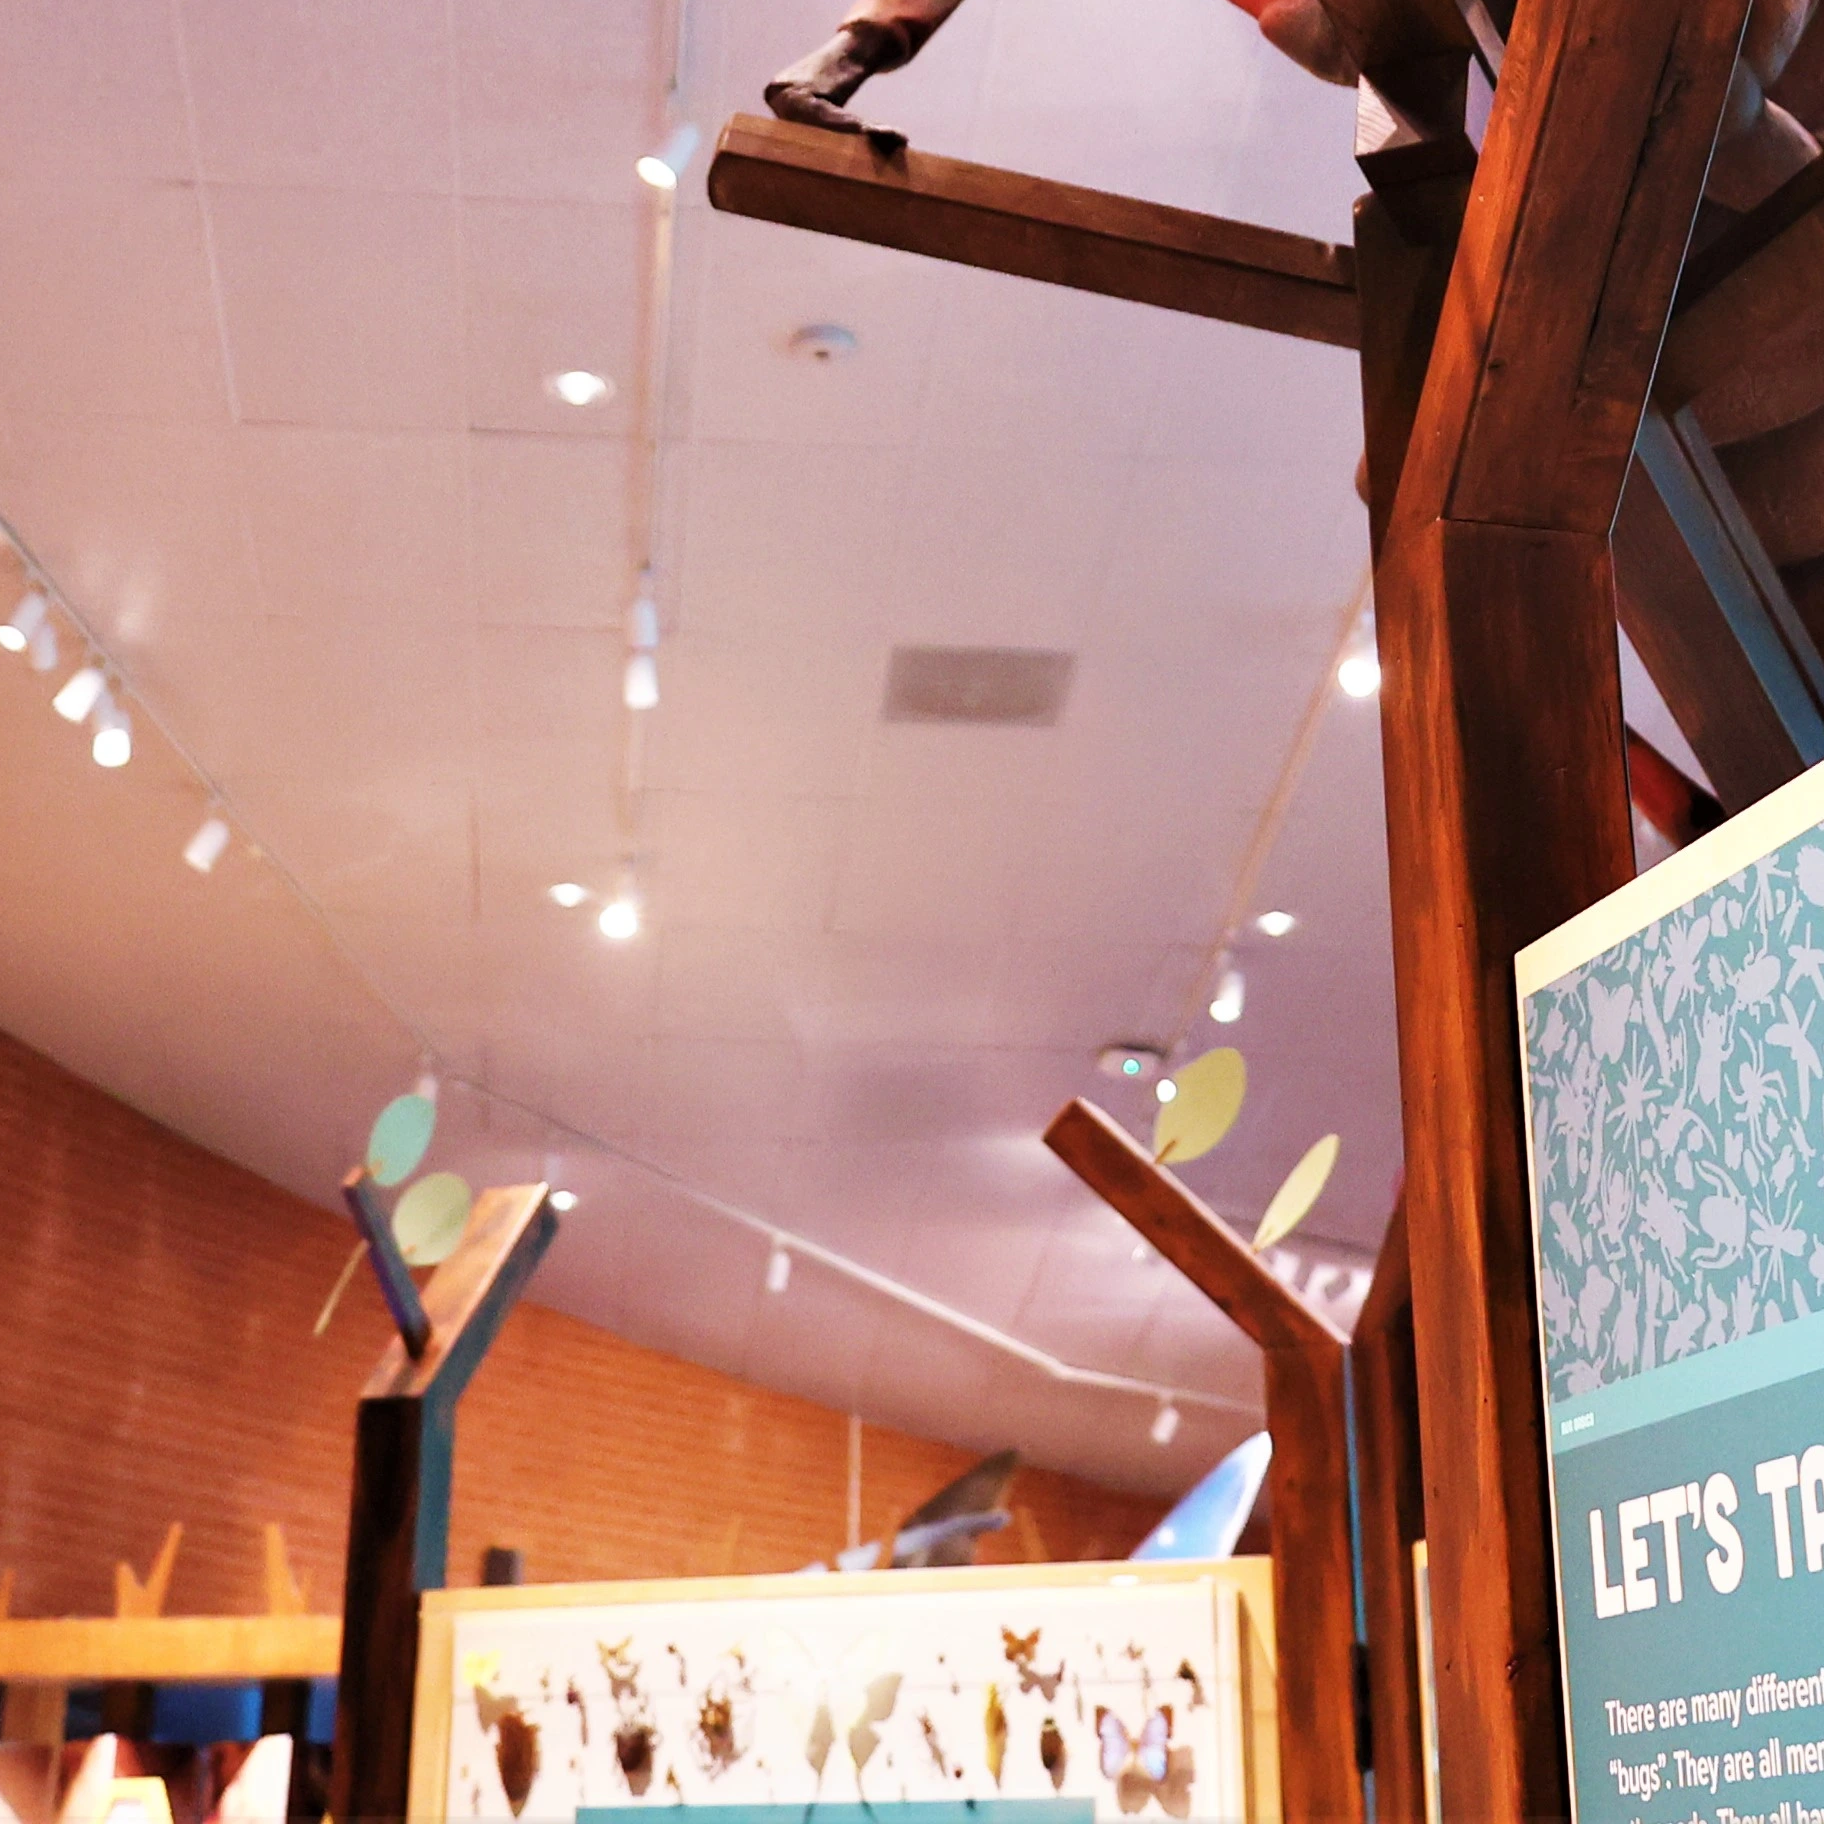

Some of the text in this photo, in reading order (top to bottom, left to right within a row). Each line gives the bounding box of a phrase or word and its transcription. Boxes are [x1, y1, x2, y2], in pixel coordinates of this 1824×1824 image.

[1605, 1700, 1655, 1736] There
[1658, 1699, 1687, 1729] are
[1691, 1688, 1740, 1728] many
[1673, 1750, 1719, 1795] They
[1724, 1750, 1755, 1783] are
[1759, 1738, 1782, 1778] all
